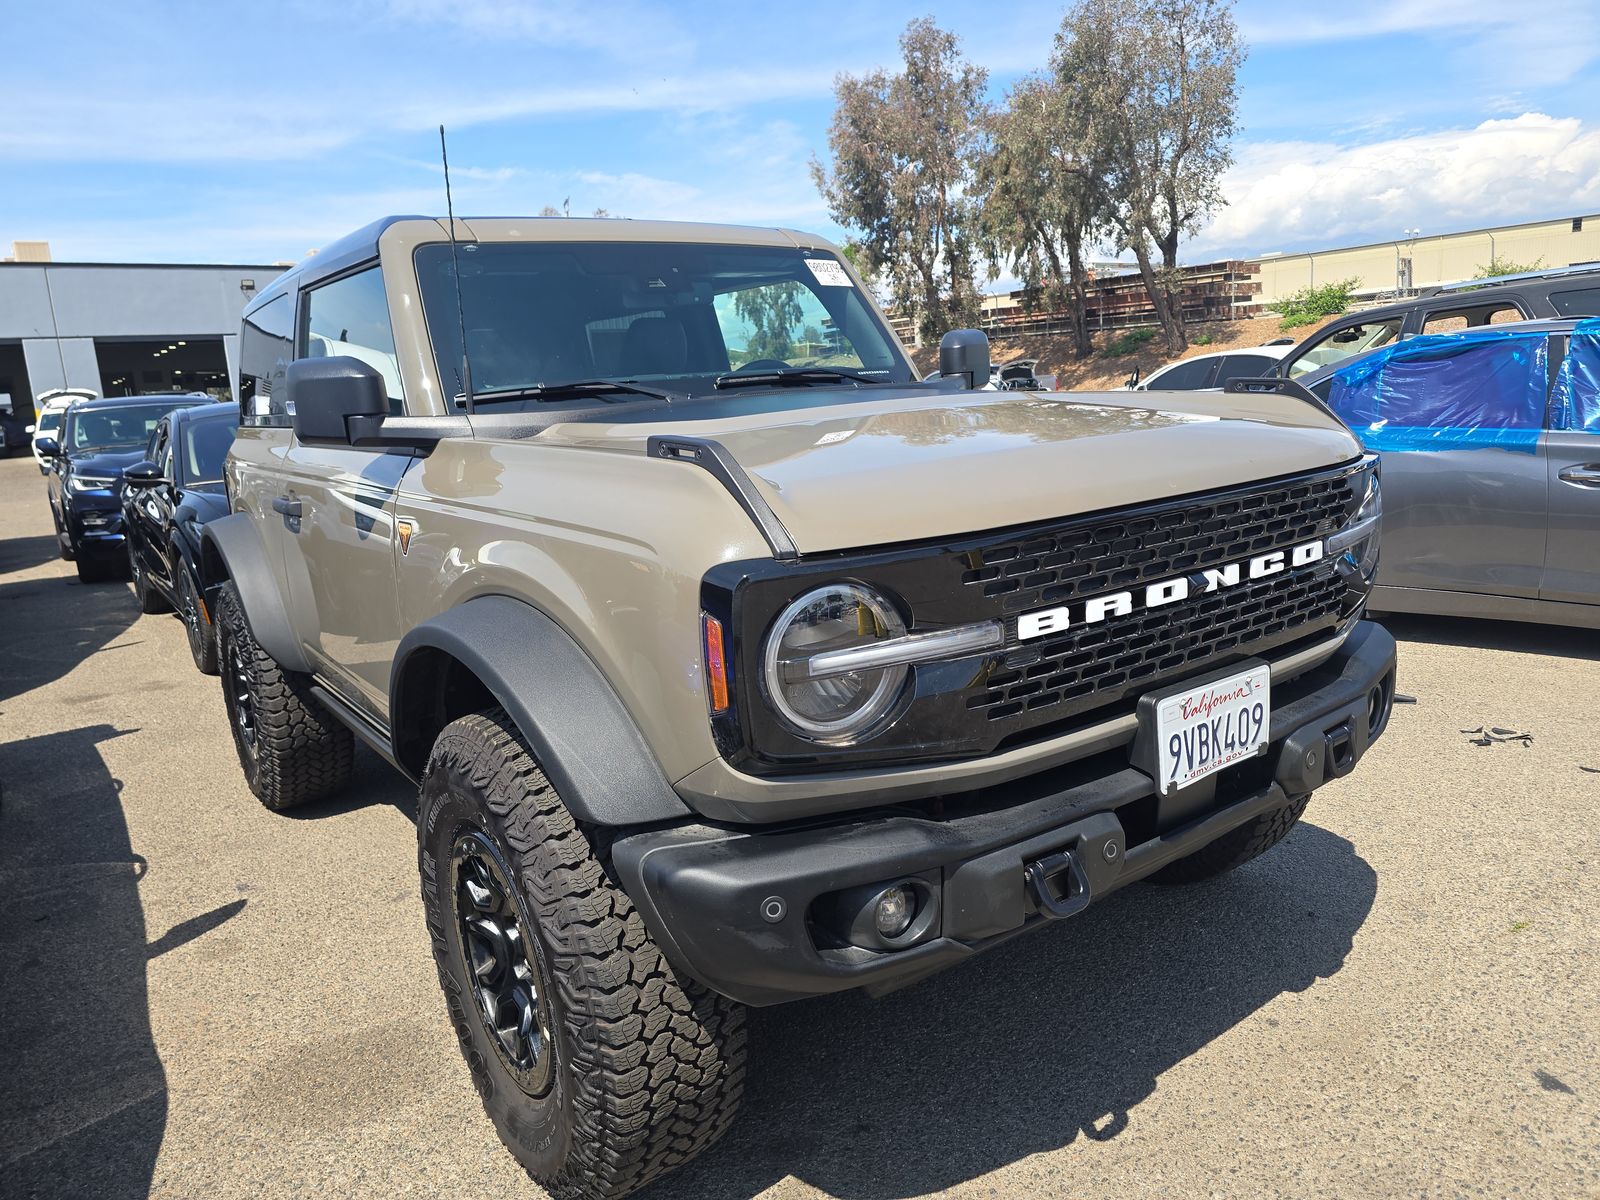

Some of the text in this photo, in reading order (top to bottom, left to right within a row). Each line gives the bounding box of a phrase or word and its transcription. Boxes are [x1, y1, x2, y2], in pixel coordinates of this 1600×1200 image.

[1017, 540, 1323, 640] BRONCO
[1182, 684, 1251, 720] California
[1169, 702, 1264, 779] 9VBK409
[1189, 750, 1244, 778] dmv.ca.gov
